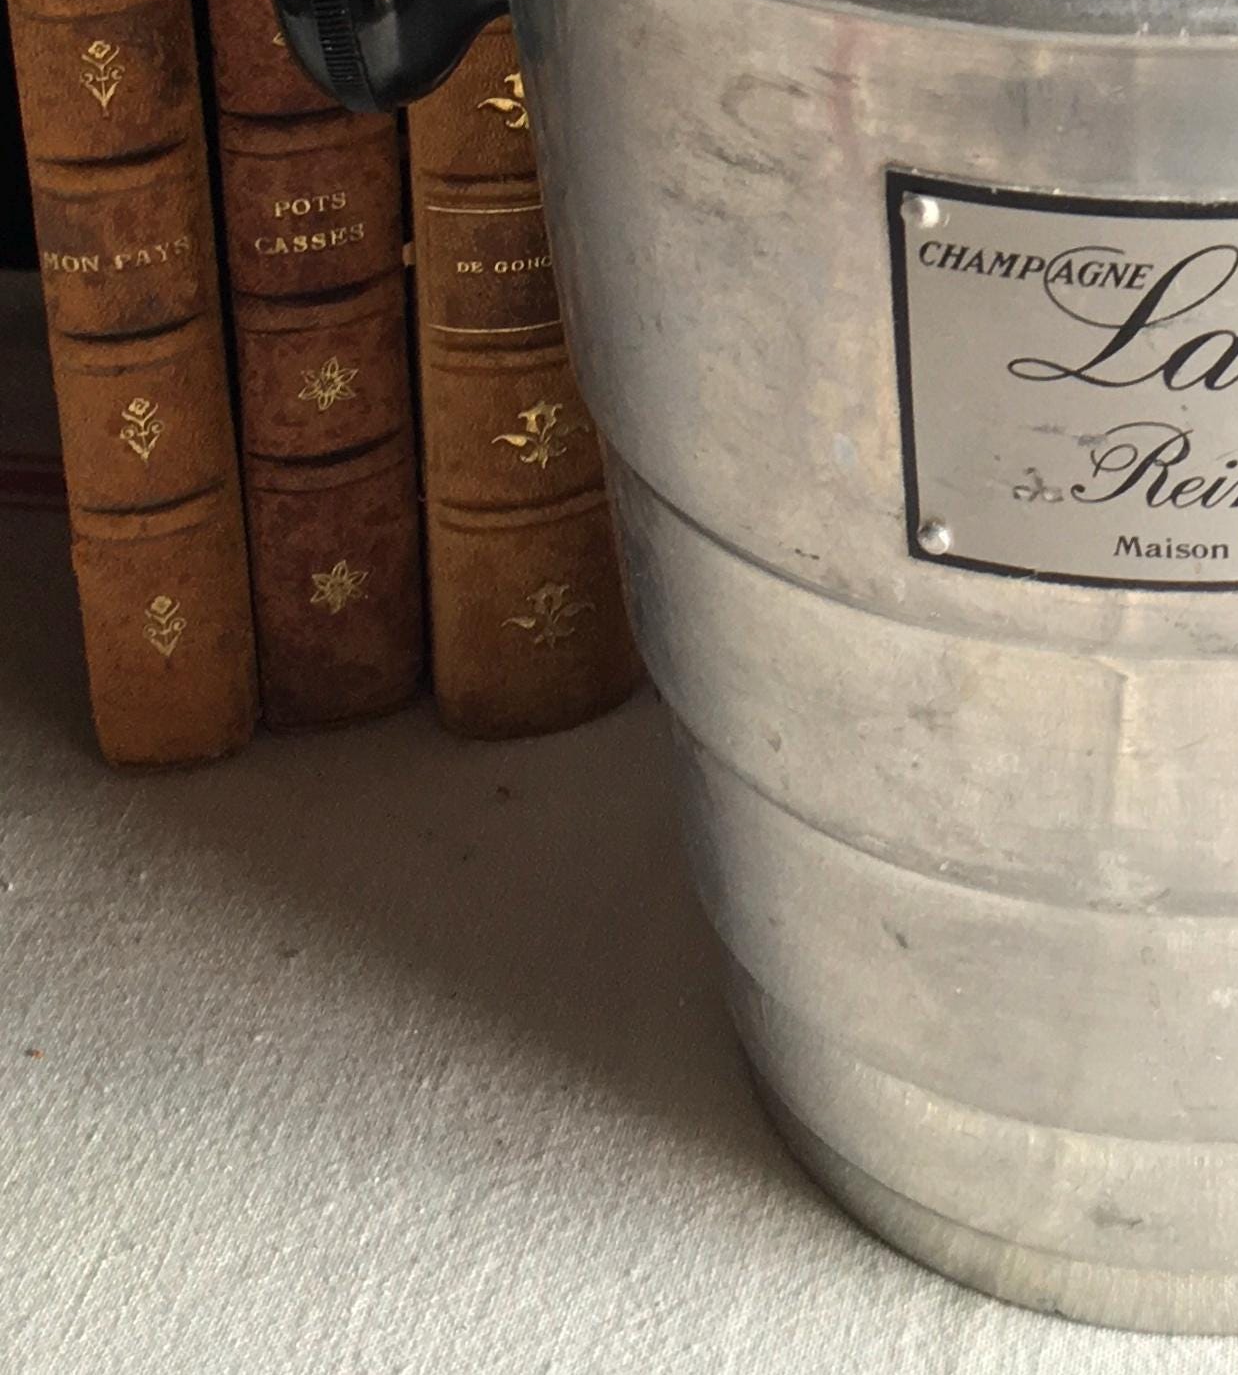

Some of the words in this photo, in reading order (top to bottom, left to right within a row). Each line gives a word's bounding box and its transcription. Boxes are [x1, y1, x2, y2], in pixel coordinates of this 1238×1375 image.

[275, 191, 347, 218] POTS
[254, 222, 366, 255] CASSES
[43, 251, 99, 273] MON
[114, 236, 191, 271] PAYS
[456, 260, 484, 275] DE
[918, 240, 1154, 293] CHAMPAGNE
[1112, 534, 1230, 560] Maison
